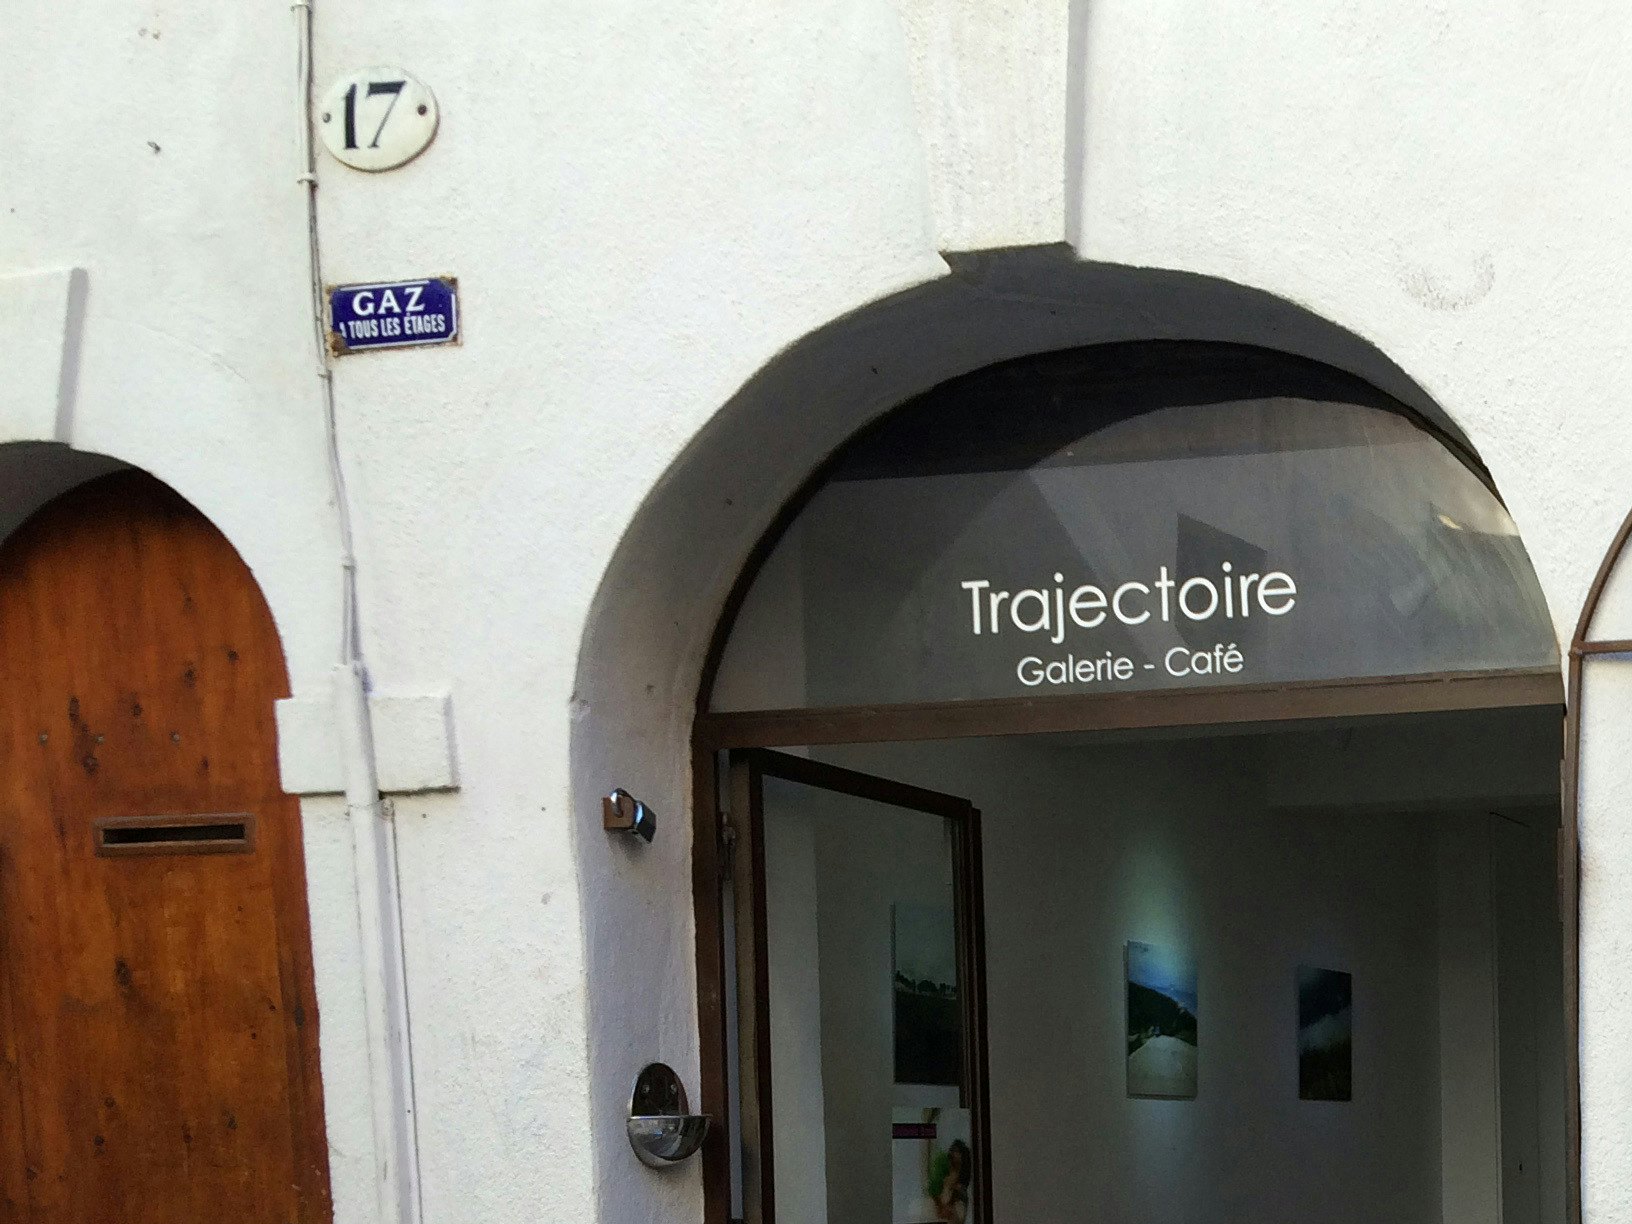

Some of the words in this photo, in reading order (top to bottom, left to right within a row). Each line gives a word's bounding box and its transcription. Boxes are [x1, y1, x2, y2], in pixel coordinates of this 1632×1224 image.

[344, 80, 407, 150] 17
[352, 286, 425, 316] GAZ
[348, 318, 379, 339] TOUS
[380, 316, 401, 337] LES
[403, 313, 446, 335] ÉTAGES
[961, 561, 1297, 644] Trajectoire
[1017, 650, 1135, 686] Galerie
[1164, 643, 1244, 677] Café
